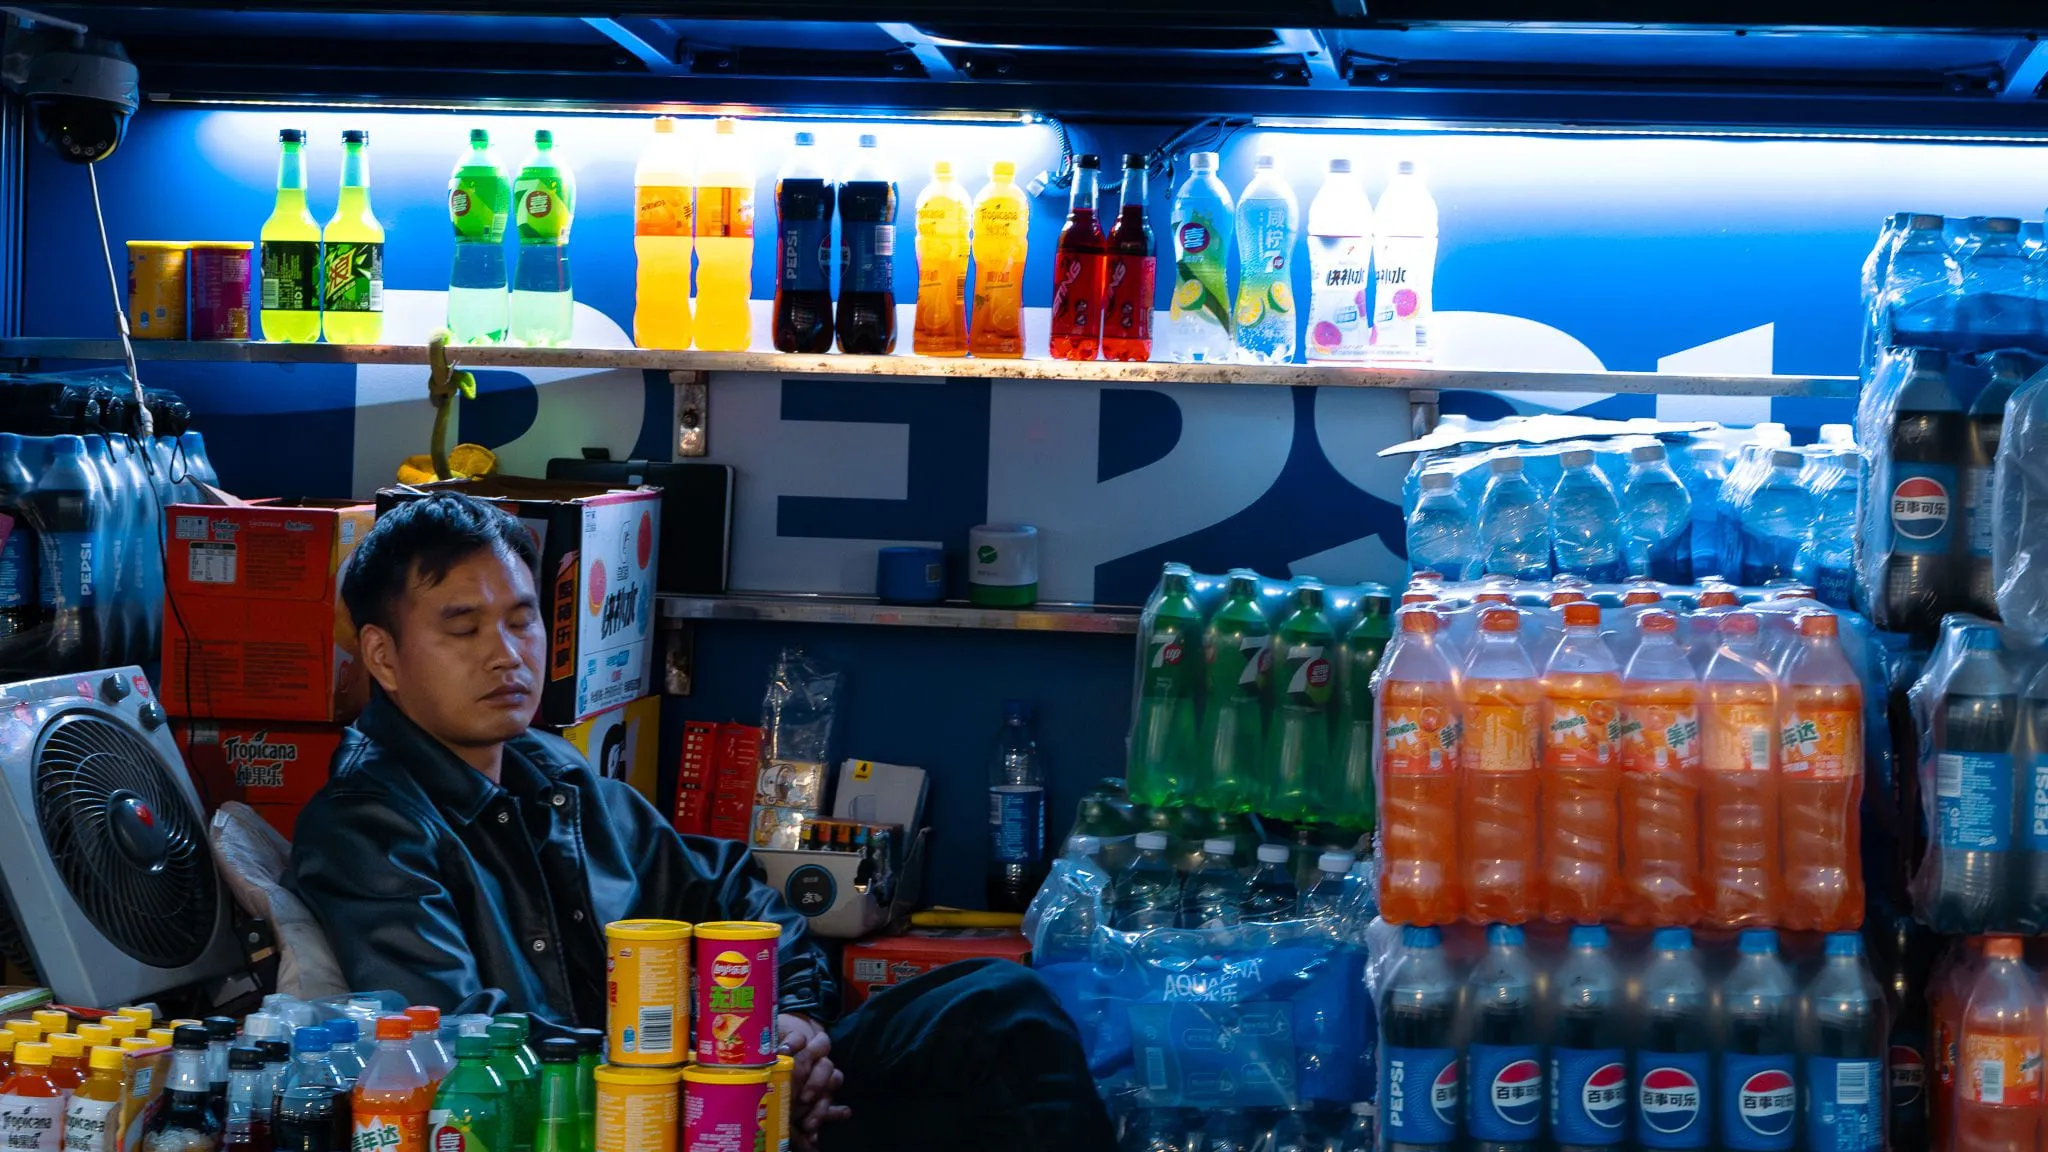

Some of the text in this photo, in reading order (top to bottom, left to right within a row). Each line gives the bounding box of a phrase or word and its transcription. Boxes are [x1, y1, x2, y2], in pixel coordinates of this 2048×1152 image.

[786, 230, 798, 280] PEPSI
[1894, 500, 1946, 516] 百事可乐
[80, 542, 92, 596] PEPSI
[223, 735, 296, 763] Tropicana
[236, 762, 284, 787] 纯果乐
[2033, 766, 2048, 836] PEPSI
[1390, 1060, 1405, 1128] PEPSI
[1642, 1091, 1697, 1108] 百事可乐
[3, 1106, 53, 1132] Tropicana
